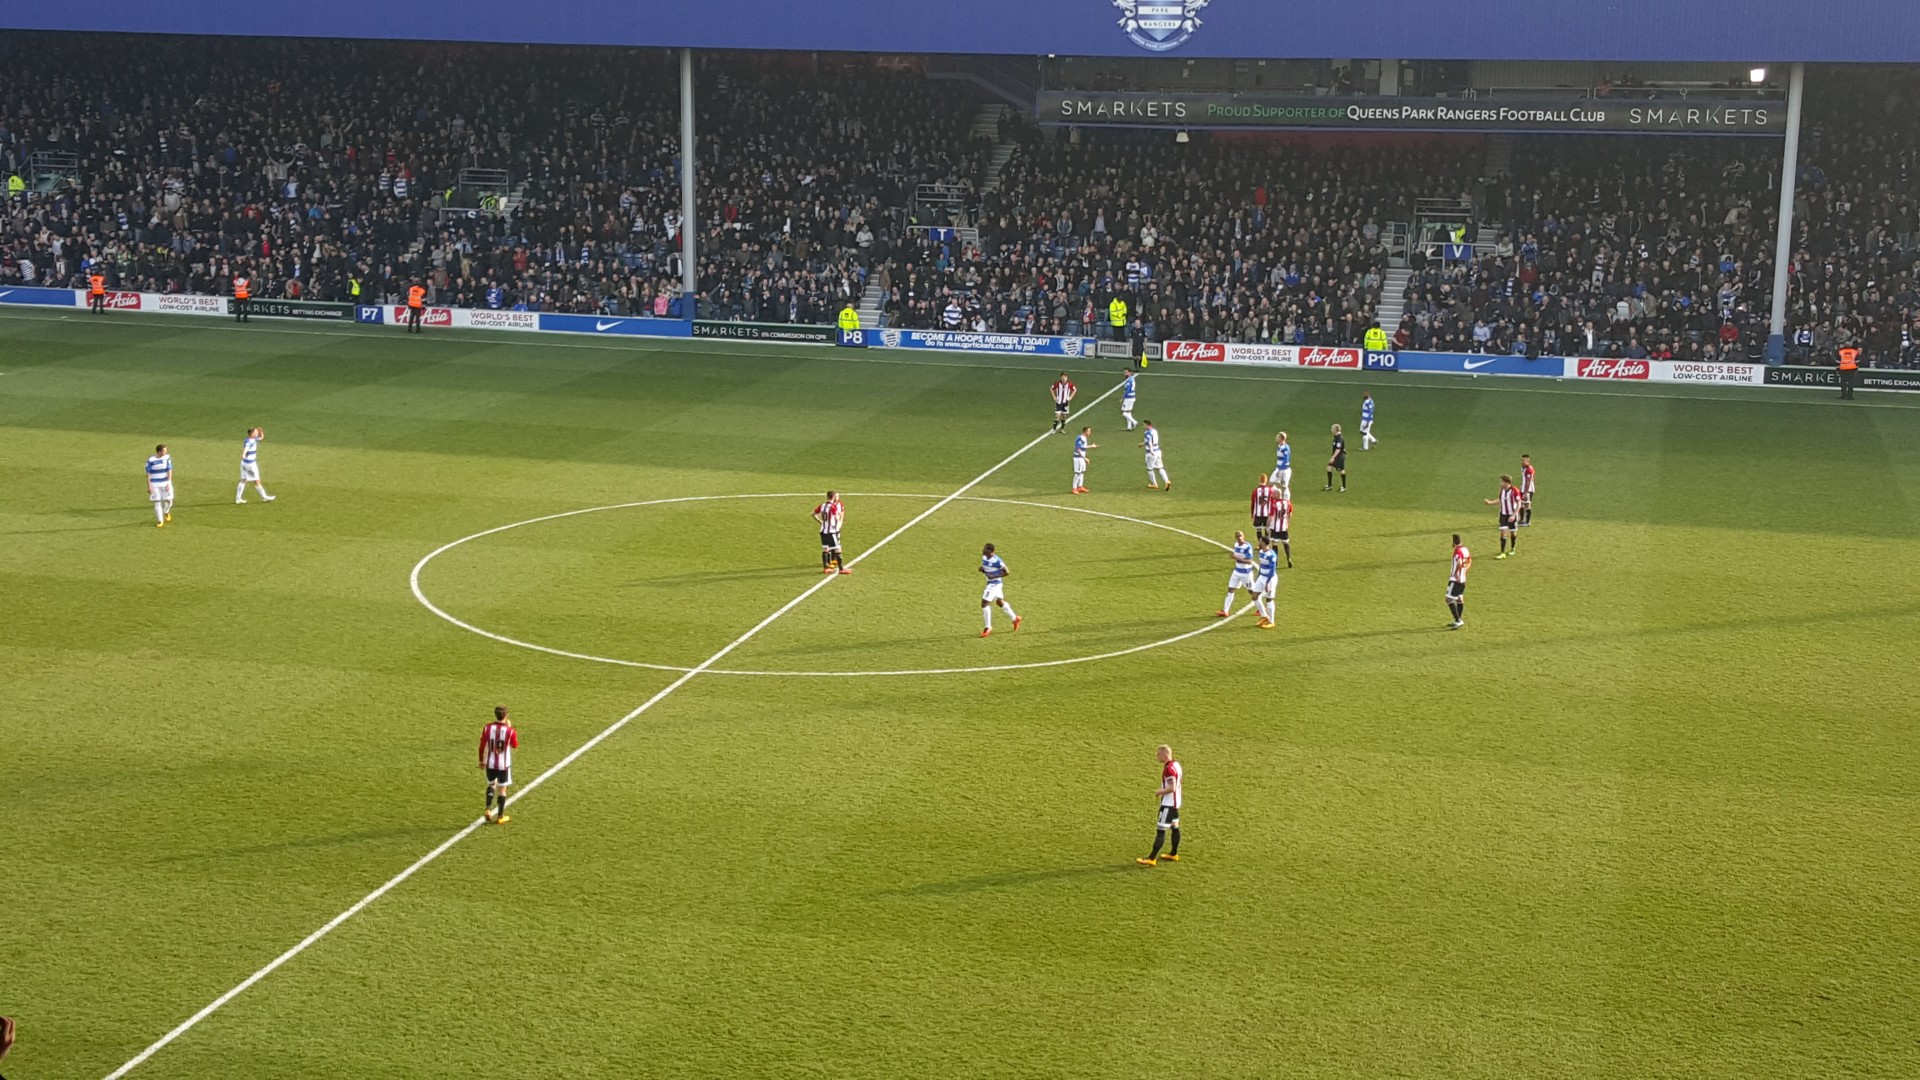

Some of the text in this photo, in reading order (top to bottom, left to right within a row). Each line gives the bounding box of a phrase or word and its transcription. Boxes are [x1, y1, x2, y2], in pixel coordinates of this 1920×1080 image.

[1061, 98, 1186, 119] SMARKETS
[1629, 105, 1767, 128] SMARKETS
[937, 228, 947, 241] T
[1452, 244, 1464, 258] V
[159, 296, 197, 305] WORLD'S
[362, 307, 378, 320] P7
[470, 311, 534, 322] WORLD'S BEST
[693, 325, 759, 337] SMARKETS
[843, 329, 863, 345] P8
[911, 332, 1050, 346] BECOME A HOOPS MEMBER TODAY!
[1014, 343, 1022, 351] to
[1231, 347, 1292, 356] WORLD'S BEST
[1368, 353, 1395, 367] P10
[1673, 363, 1754, 375] WORLD'S BEST
[1673, 373, 1753, 382] LOW-COST AIRLINE
[1863, 378, 1893, 386] BETTING
